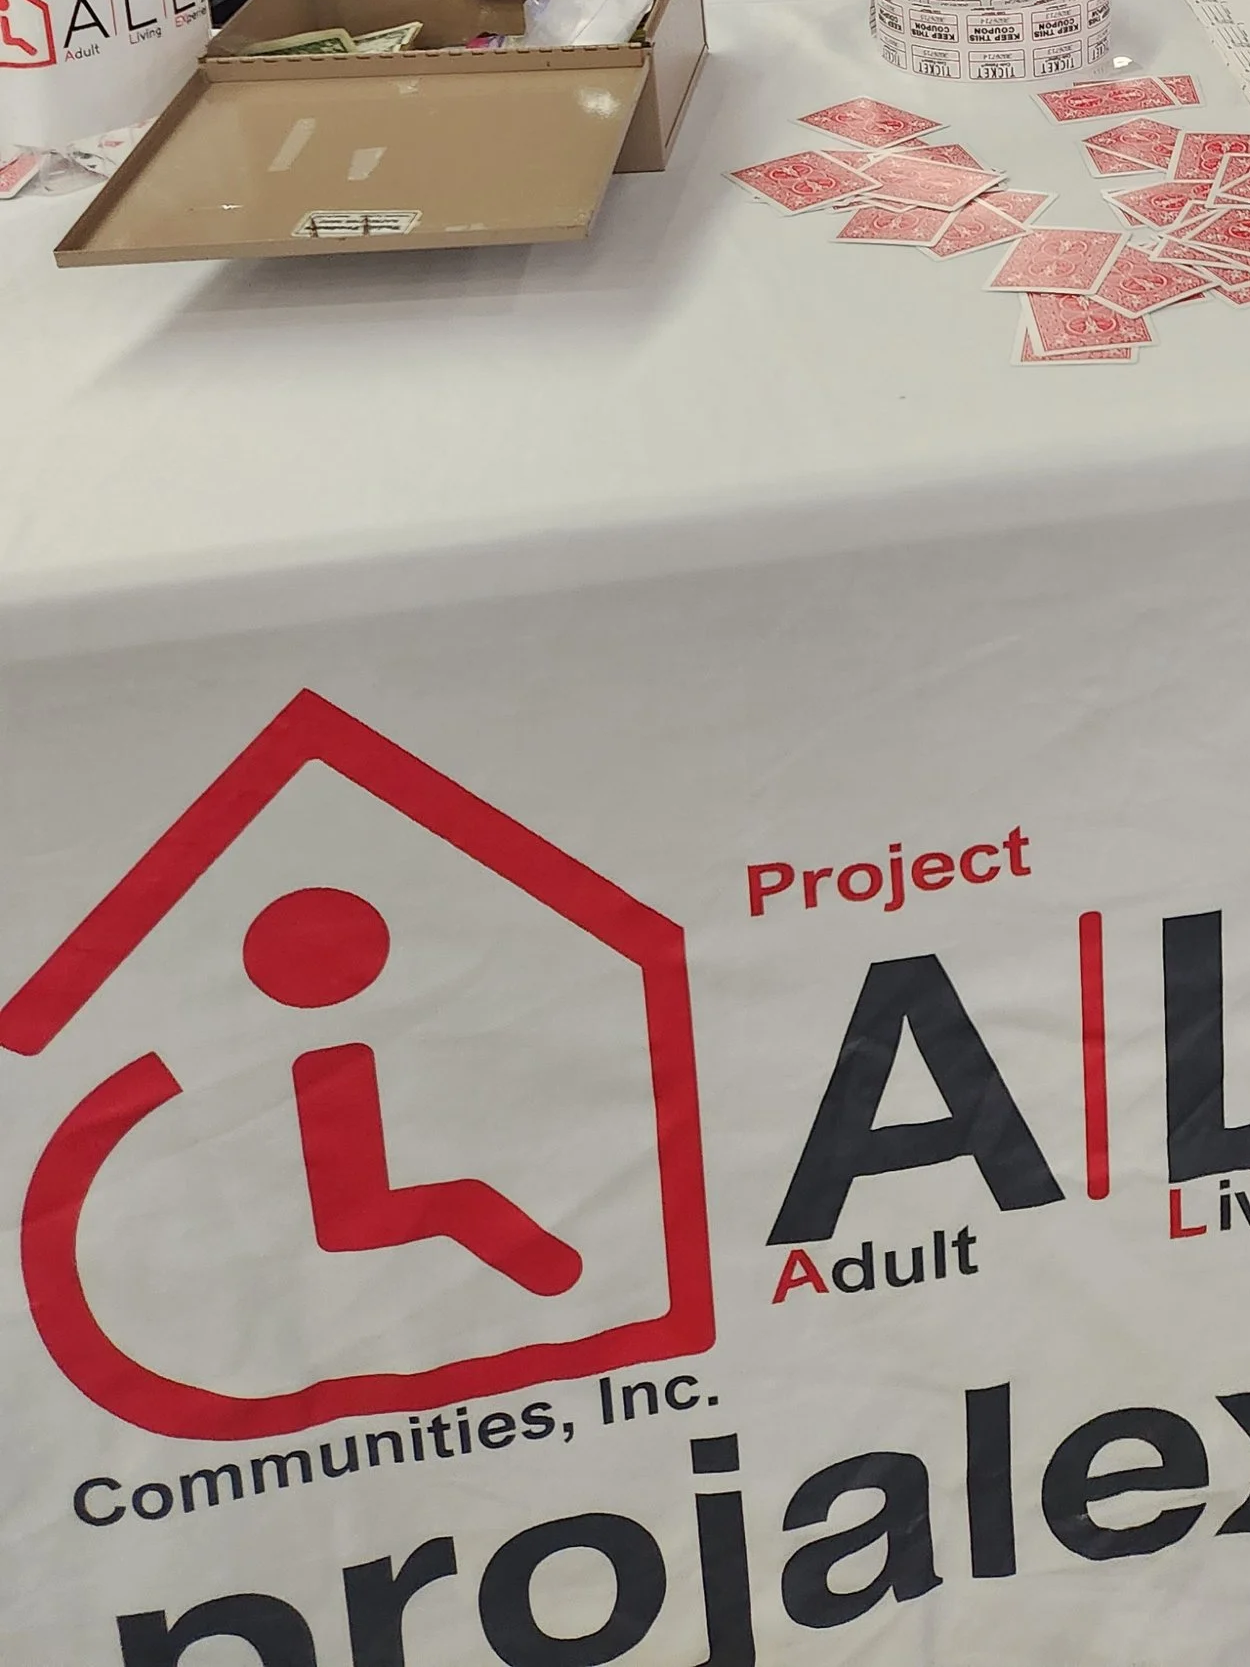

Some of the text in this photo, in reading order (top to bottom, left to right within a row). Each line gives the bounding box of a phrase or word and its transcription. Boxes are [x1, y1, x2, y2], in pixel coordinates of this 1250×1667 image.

[914, 22, 950, 33] COUPON
[974, 26, 1015, 34] COUPON
[1034, 23, 1079, 38] KEEP THIS
[1038, 18, 1075, 30] COUPON
[129, 25, 162, 45] Living
[911, 28, 955, 41] KEEP THIS
[64, 43, 101, 63] Adult
[919, 61, 951, 77] TICKET
[977, 67, 1015, 78] TICKET
[1040, 57, 1075, 74] TICKET
[747, 825, 1032, 917] Project
[771, 1224, 979, 1305] Adult
[73, 1373, 719, 1527] Communities, Inc.
